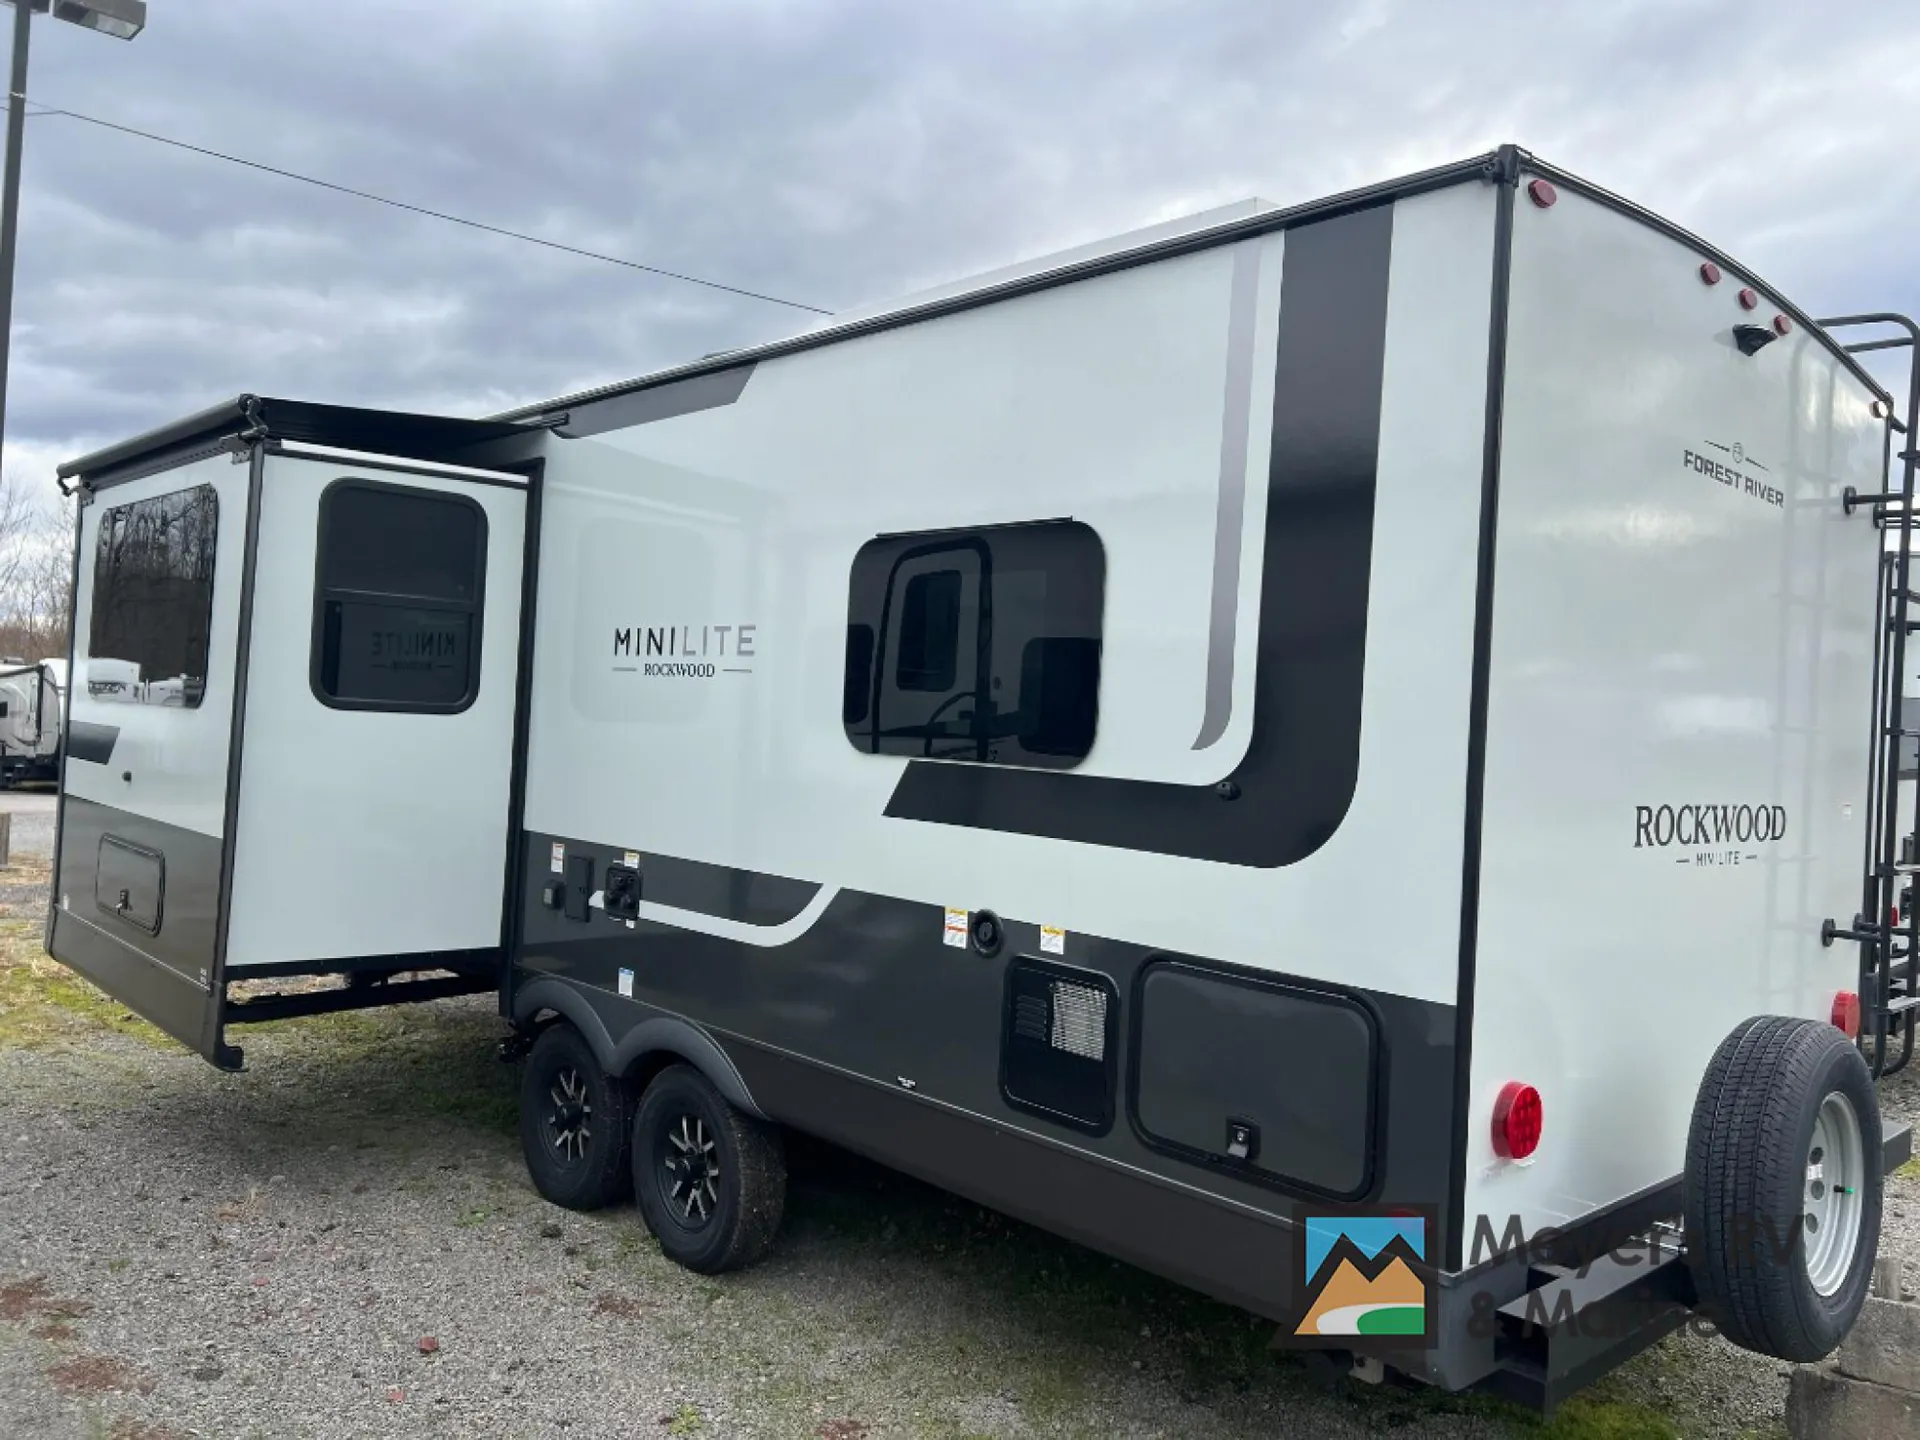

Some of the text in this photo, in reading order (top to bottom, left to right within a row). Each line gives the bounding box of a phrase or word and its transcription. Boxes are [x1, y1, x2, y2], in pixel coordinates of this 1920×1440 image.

[1683, 449, 1784, 508] FOREST RIVER
[644, 663, 715, 678] ROCKWOOD
[1634, 804, 1787, 848] ROCKWOOD
